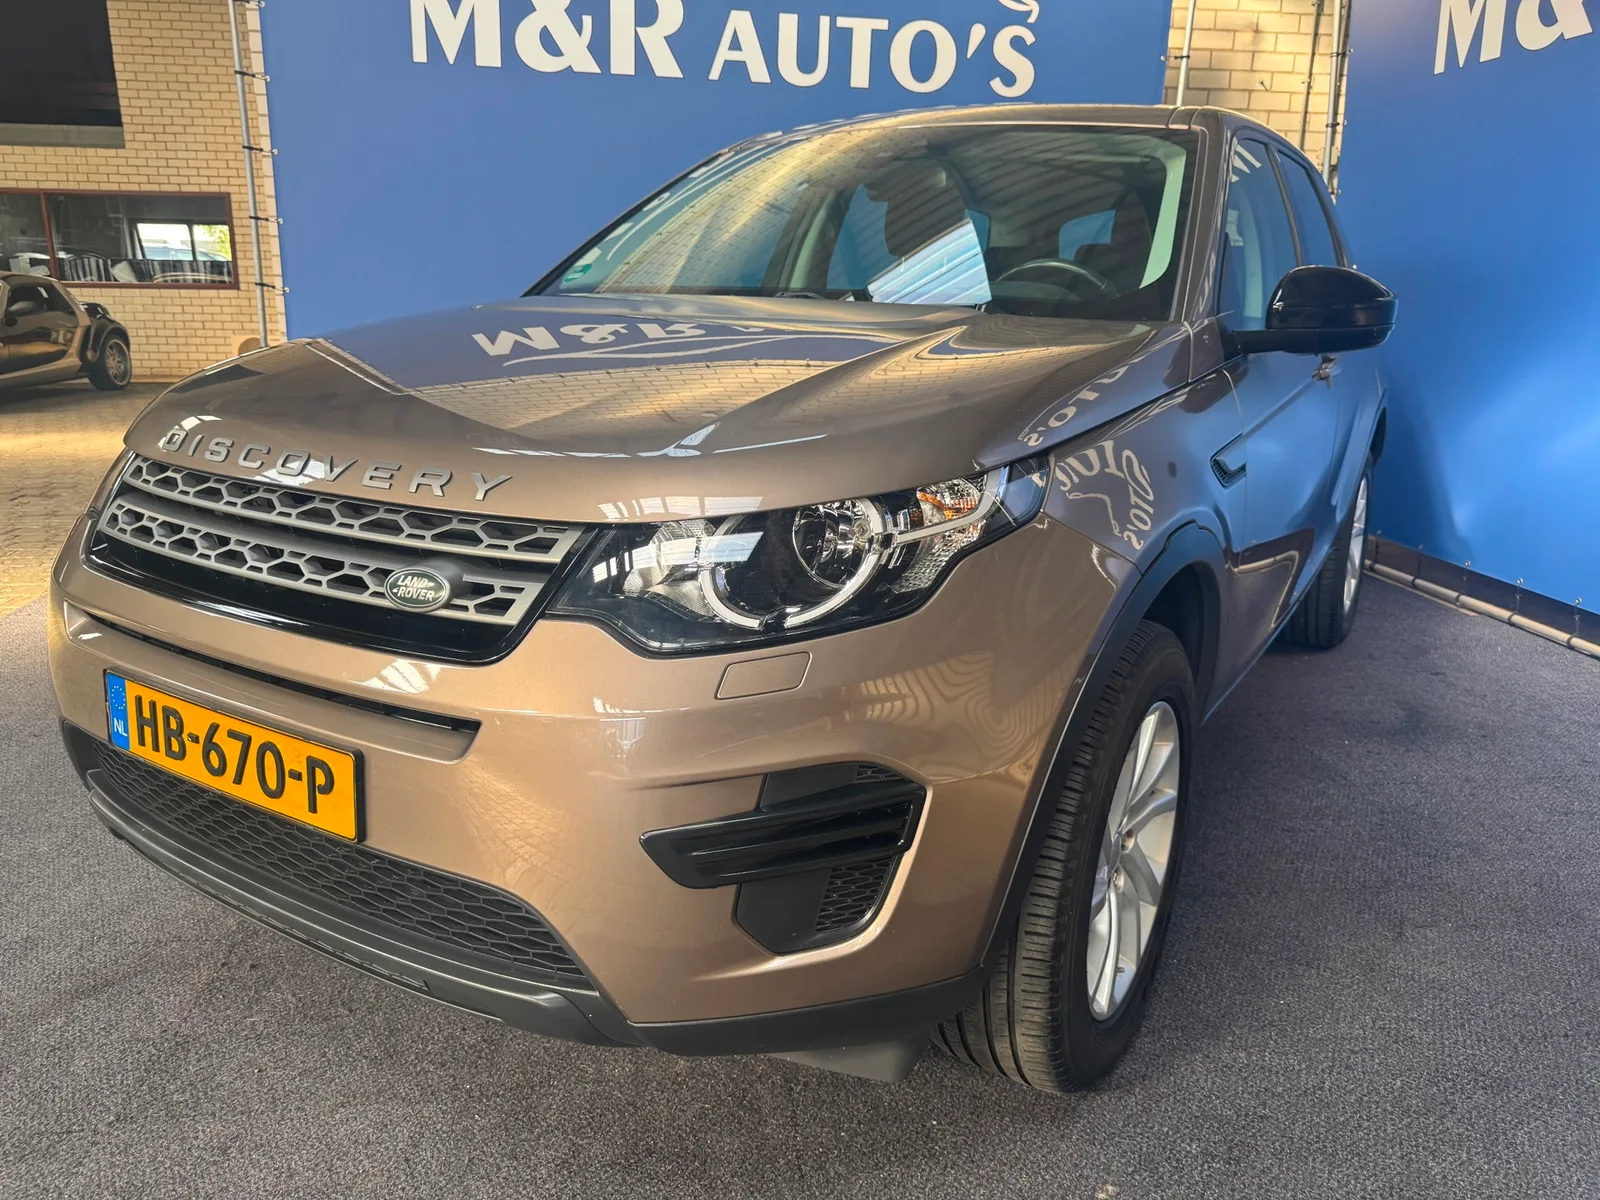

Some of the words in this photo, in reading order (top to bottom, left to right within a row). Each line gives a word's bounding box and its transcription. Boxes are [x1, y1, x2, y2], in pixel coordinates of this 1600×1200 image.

[410, 0, 684, 78] M&R
[708, 9, 1037, 98] AUTO'S
[161, 428, 512, 501] DISCOVERY
[396, 586, 435, 601] ROVER
[397, 575, 429, 589] LAND
[113, 717, 128, 737] NL
[134, 694, 335, 815] HB-670-P
